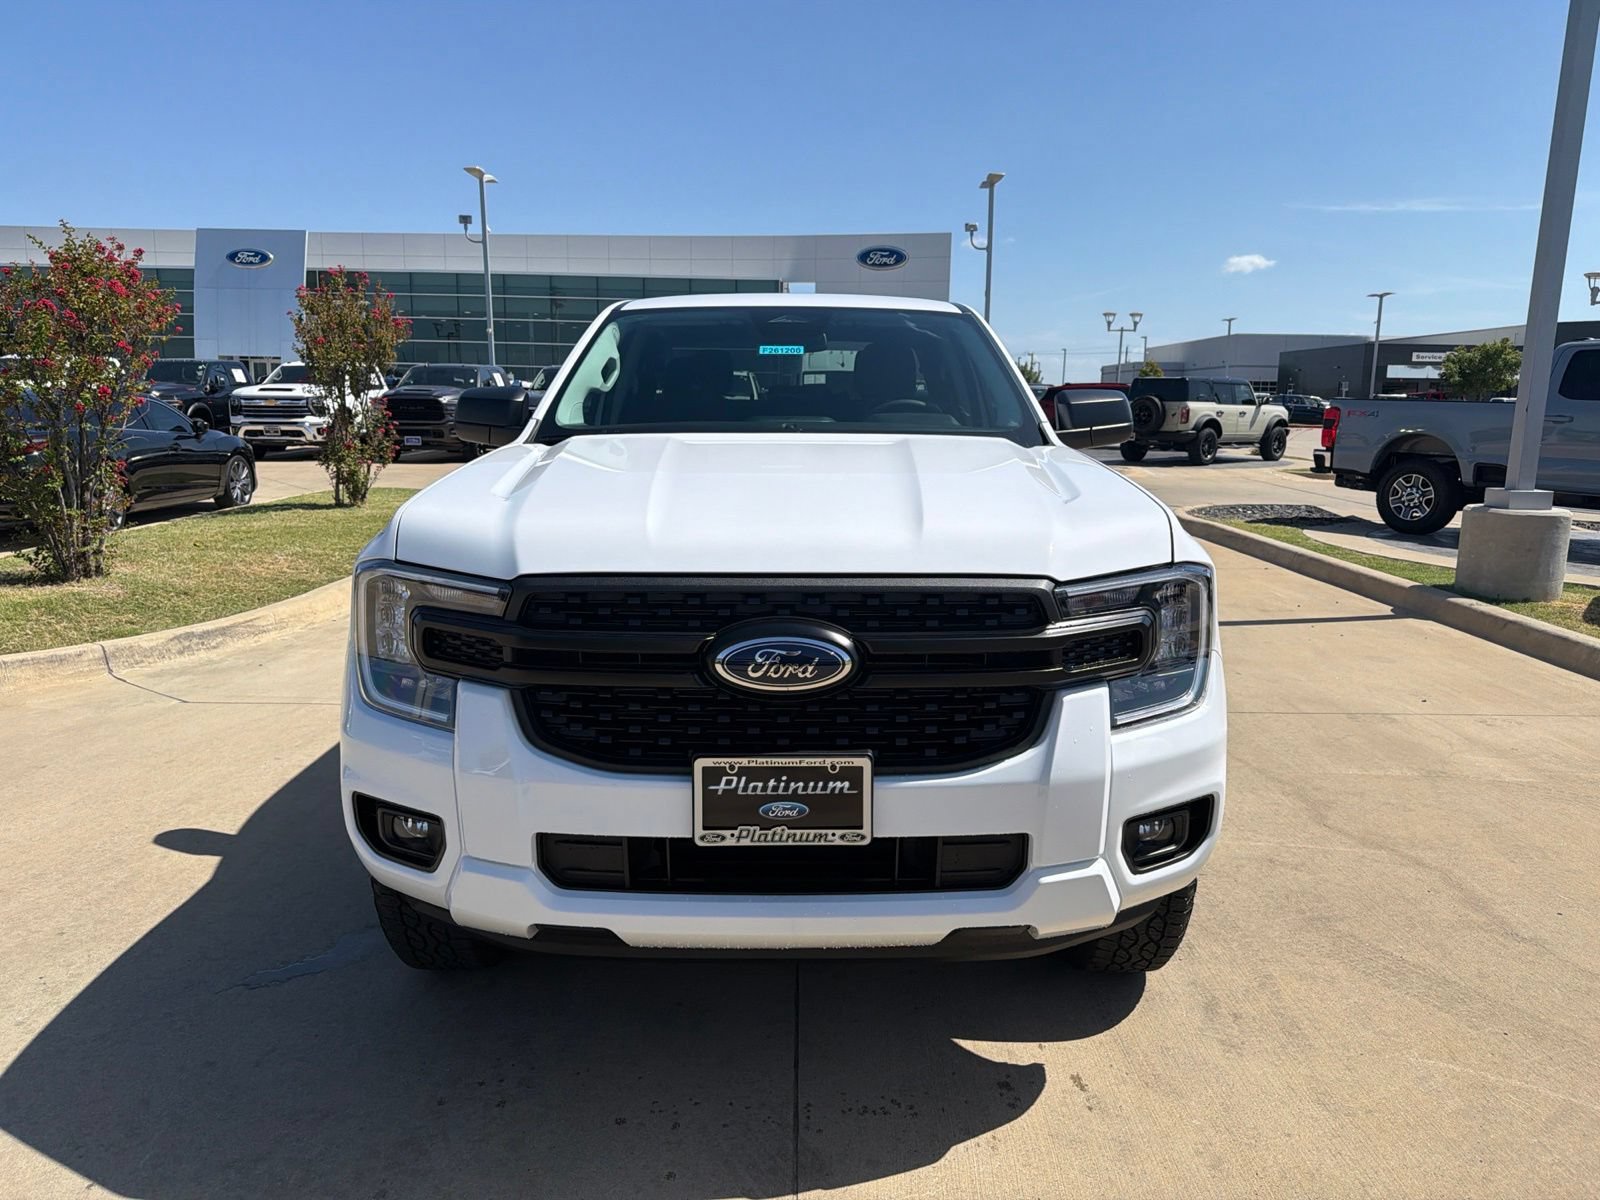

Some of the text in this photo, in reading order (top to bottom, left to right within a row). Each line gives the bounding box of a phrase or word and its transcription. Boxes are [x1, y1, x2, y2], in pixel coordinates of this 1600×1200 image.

[235, 251, 262, 263] Ford
[866, 251, 897, 264] Ford
[1346, 409, 1379, 418] FX4
[747, 648, 820, 678] Ford
[707, 775, 859, 796] Platinum
[768, 803, 800, 818] Ford
[703, 834, 723, 842] Ford
[734, 827, 836, 844] Platinum
[843, 834, 862, 842] Ford
